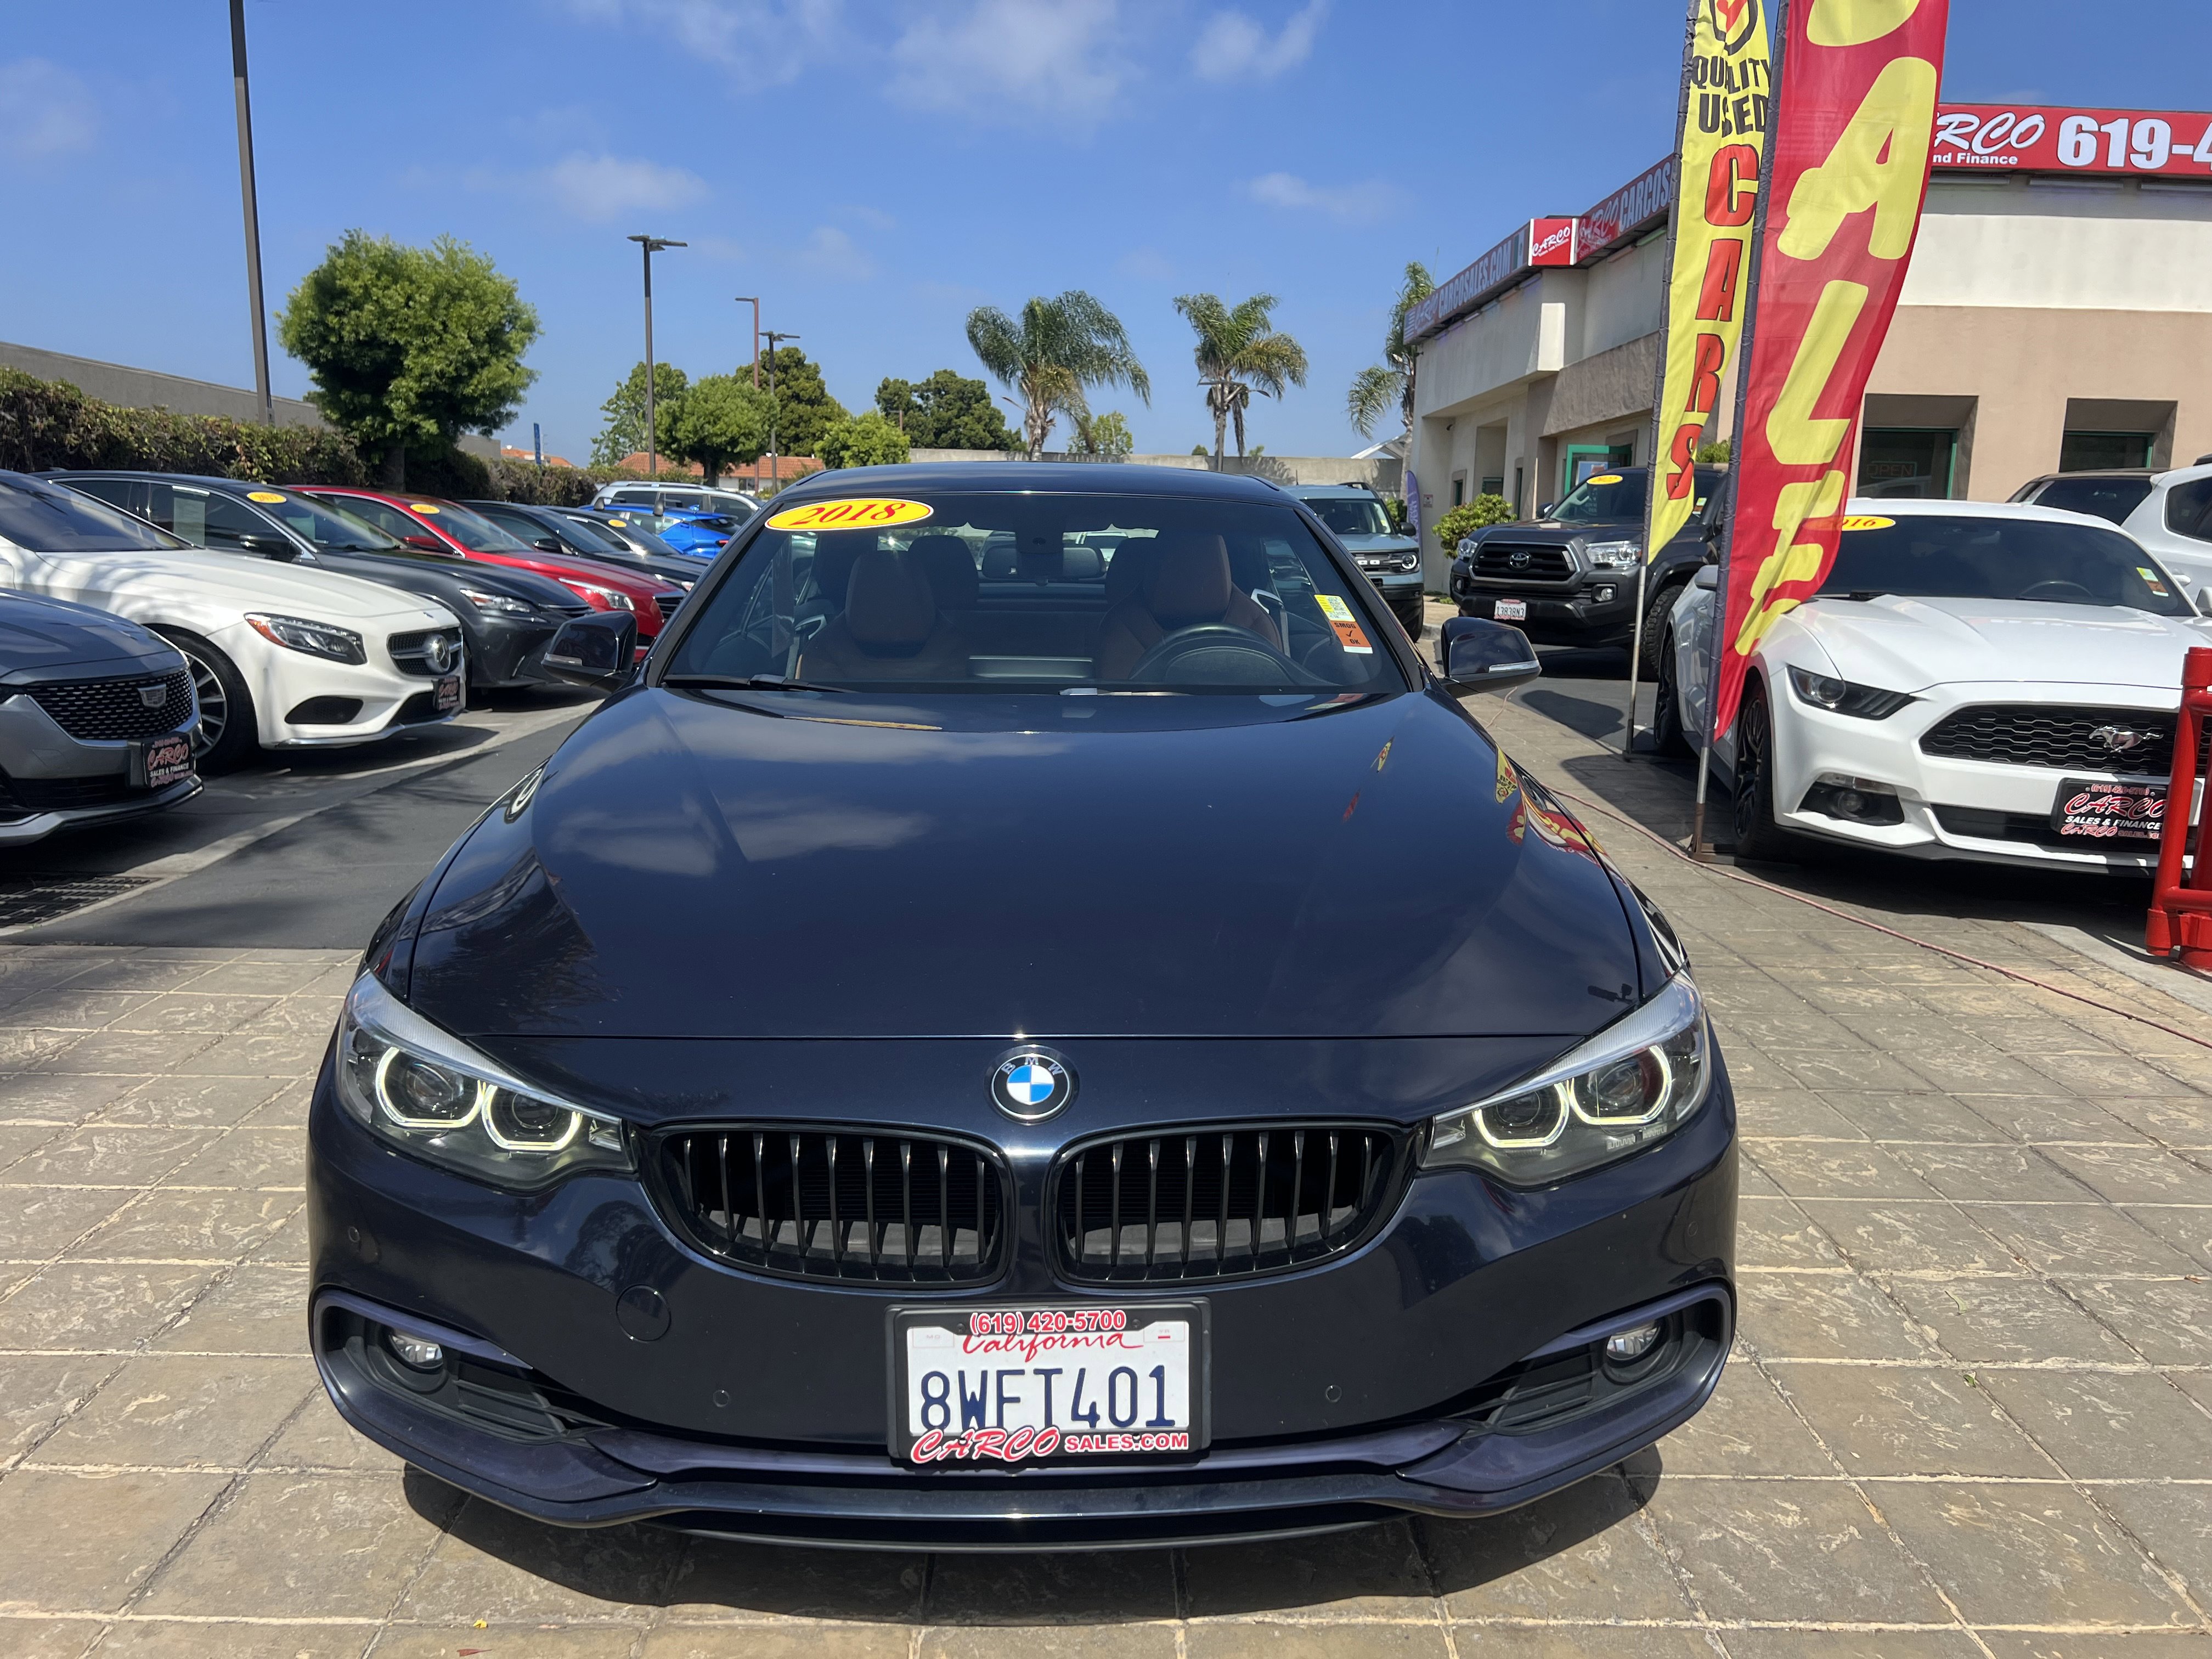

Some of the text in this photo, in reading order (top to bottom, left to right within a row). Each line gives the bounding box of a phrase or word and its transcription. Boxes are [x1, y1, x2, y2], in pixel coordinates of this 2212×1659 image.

[1699, 93, 1768, 138] USED
[1933, 111, 2045, 155] RCO
[1932, 151, 2018, 165] nd Finance
[1618, 162, 1672, 233] CARCOS
[1532, 226, 1570, 257] CARCO
[1438, 240, 1511, 318] CARCOSALES.COM
[1667, 143, 1760, 500] CARS
[1866, 464, 1913, 477] OPEN
[788, 503, 906, 526] 2018
[1842, 518, 1876, 527] 16
[148, 743, 189, 771] CARCO
[2064, 793, 2168, 820] CARCO
[2061, 823, 2161, 839] CARCO SALES.CO
[2065, 816, 2101, 825] SALES
[2113, 820, 2162, 830] FINANCE
[1001, 1057, 1063, 1076] BMW
[969, 1310, 1126, 1336] (619) 420-5700
[962, 1332, 1144, 1363] California
[920, 1364, 1176, 1430] 8WFT401
[910, 1426, 1189, 1464] CARCO SALES.COM
